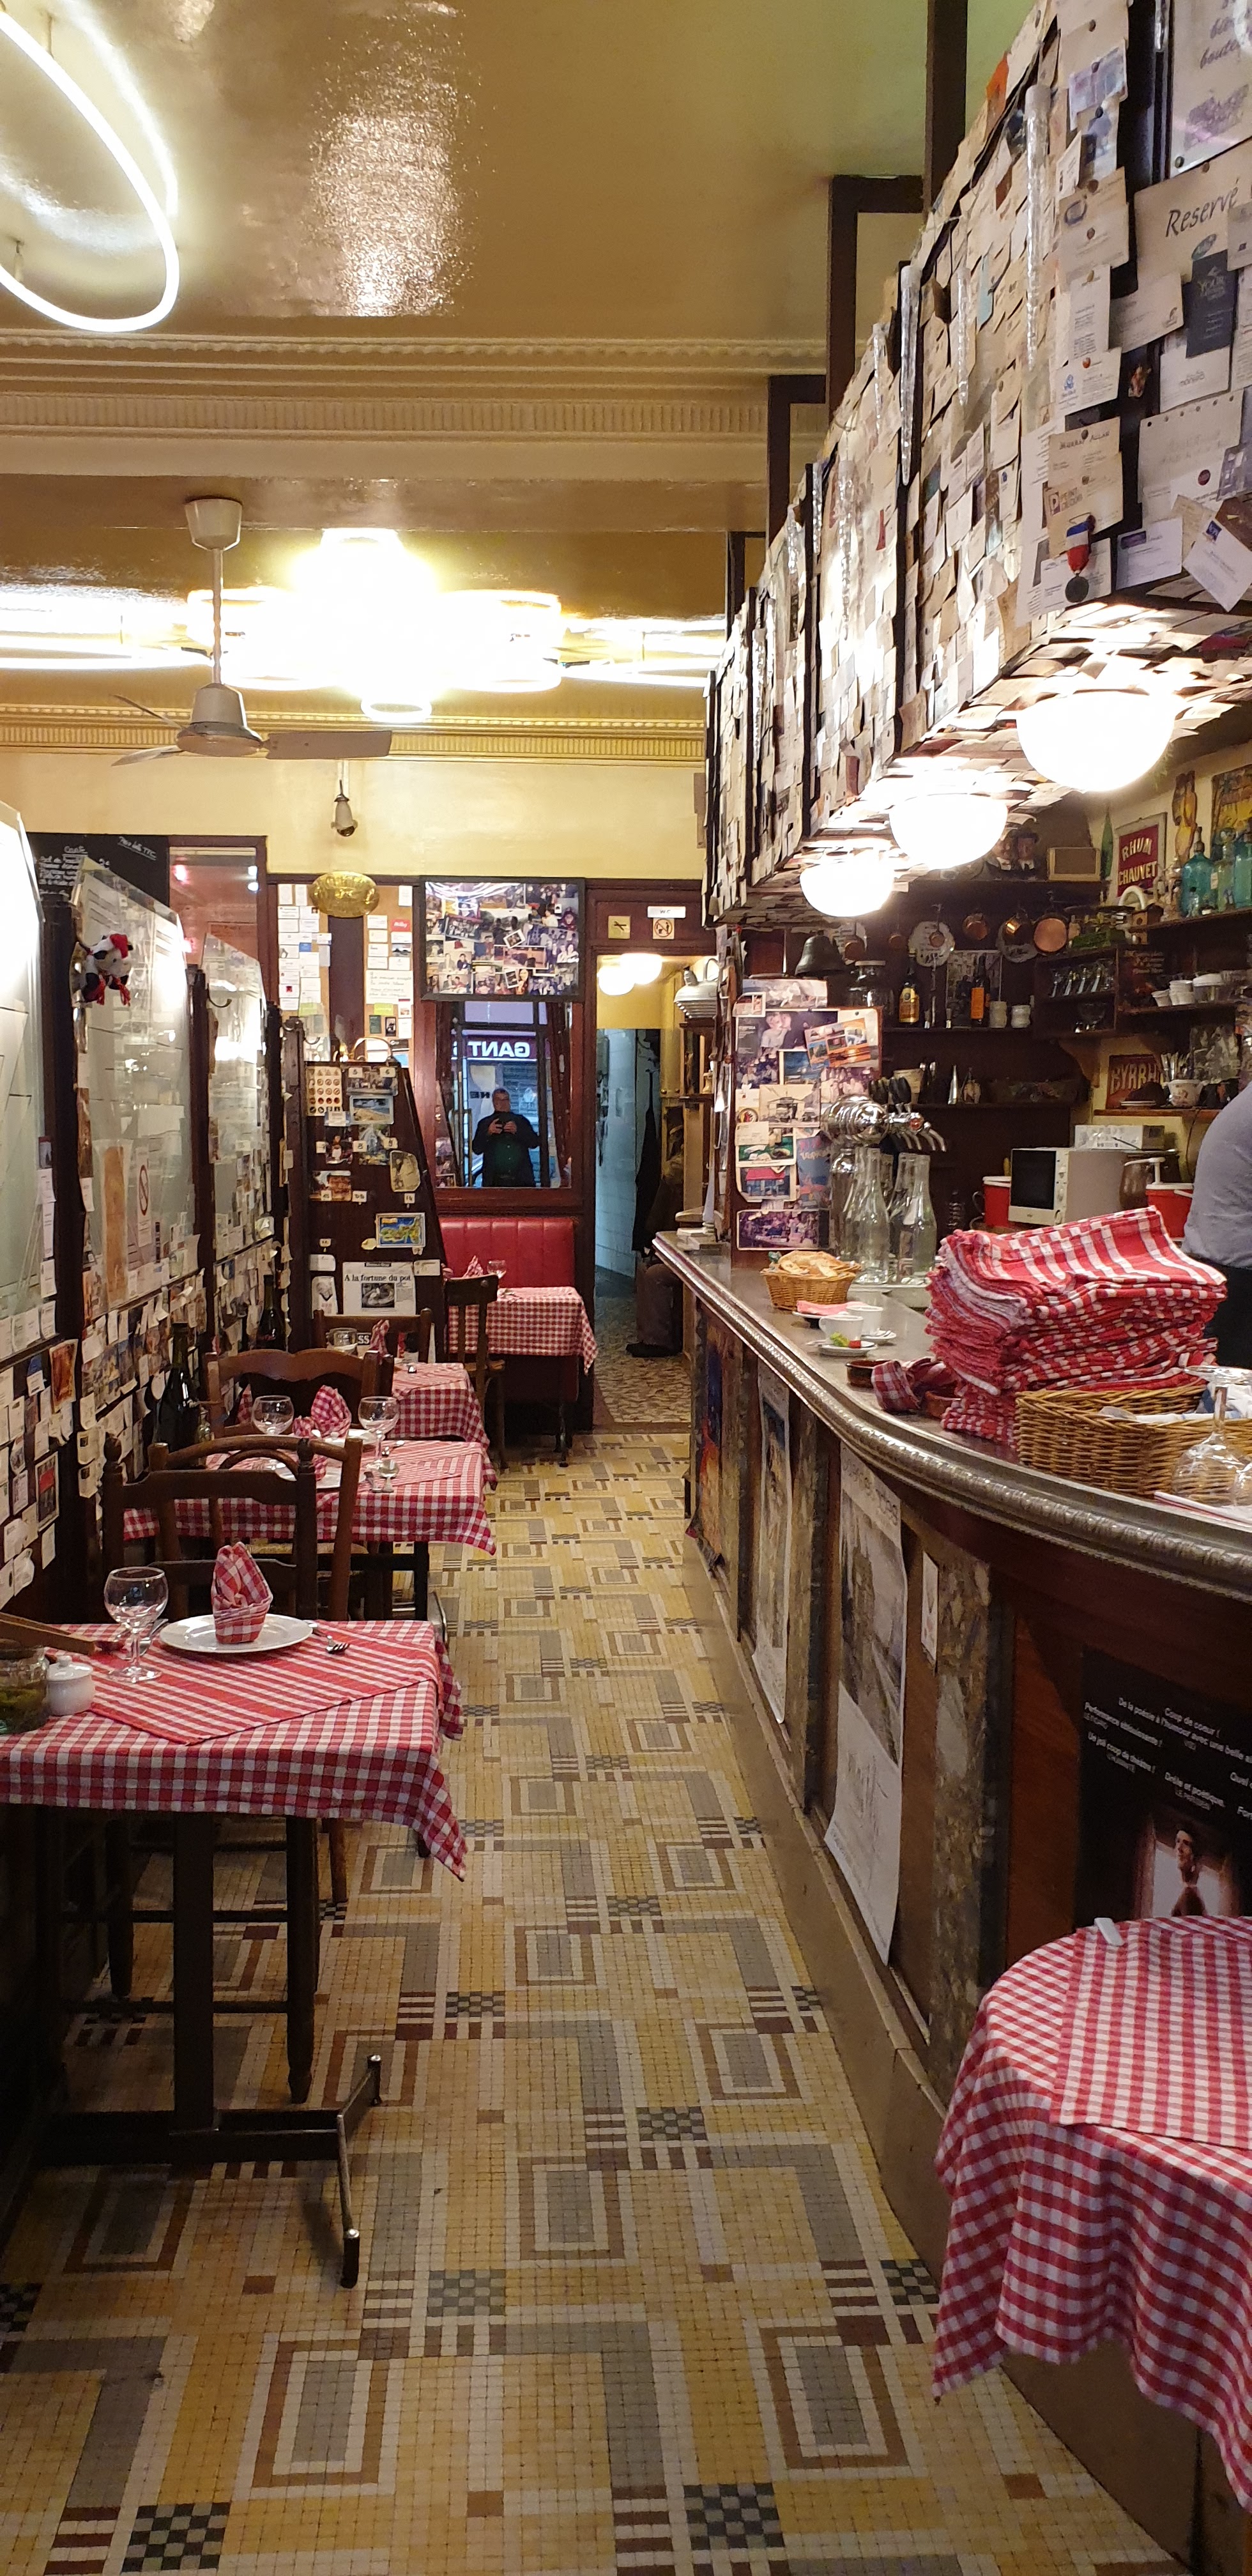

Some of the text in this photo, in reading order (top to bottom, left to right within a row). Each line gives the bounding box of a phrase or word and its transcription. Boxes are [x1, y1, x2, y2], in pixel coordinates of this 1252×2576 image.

[1122, 837, 1152, 861] RHUM
[1118, 861, 1157, 885] CHAUVET
[1165, 1708, 1182, 1723] Coup
[1184, 1717, 1193, 1726] de
[1192, 1733, 1209, 1745] avec
[1209, 1741, 1224, 1752] une
[1225, 1745, 1244, 1760] belle
